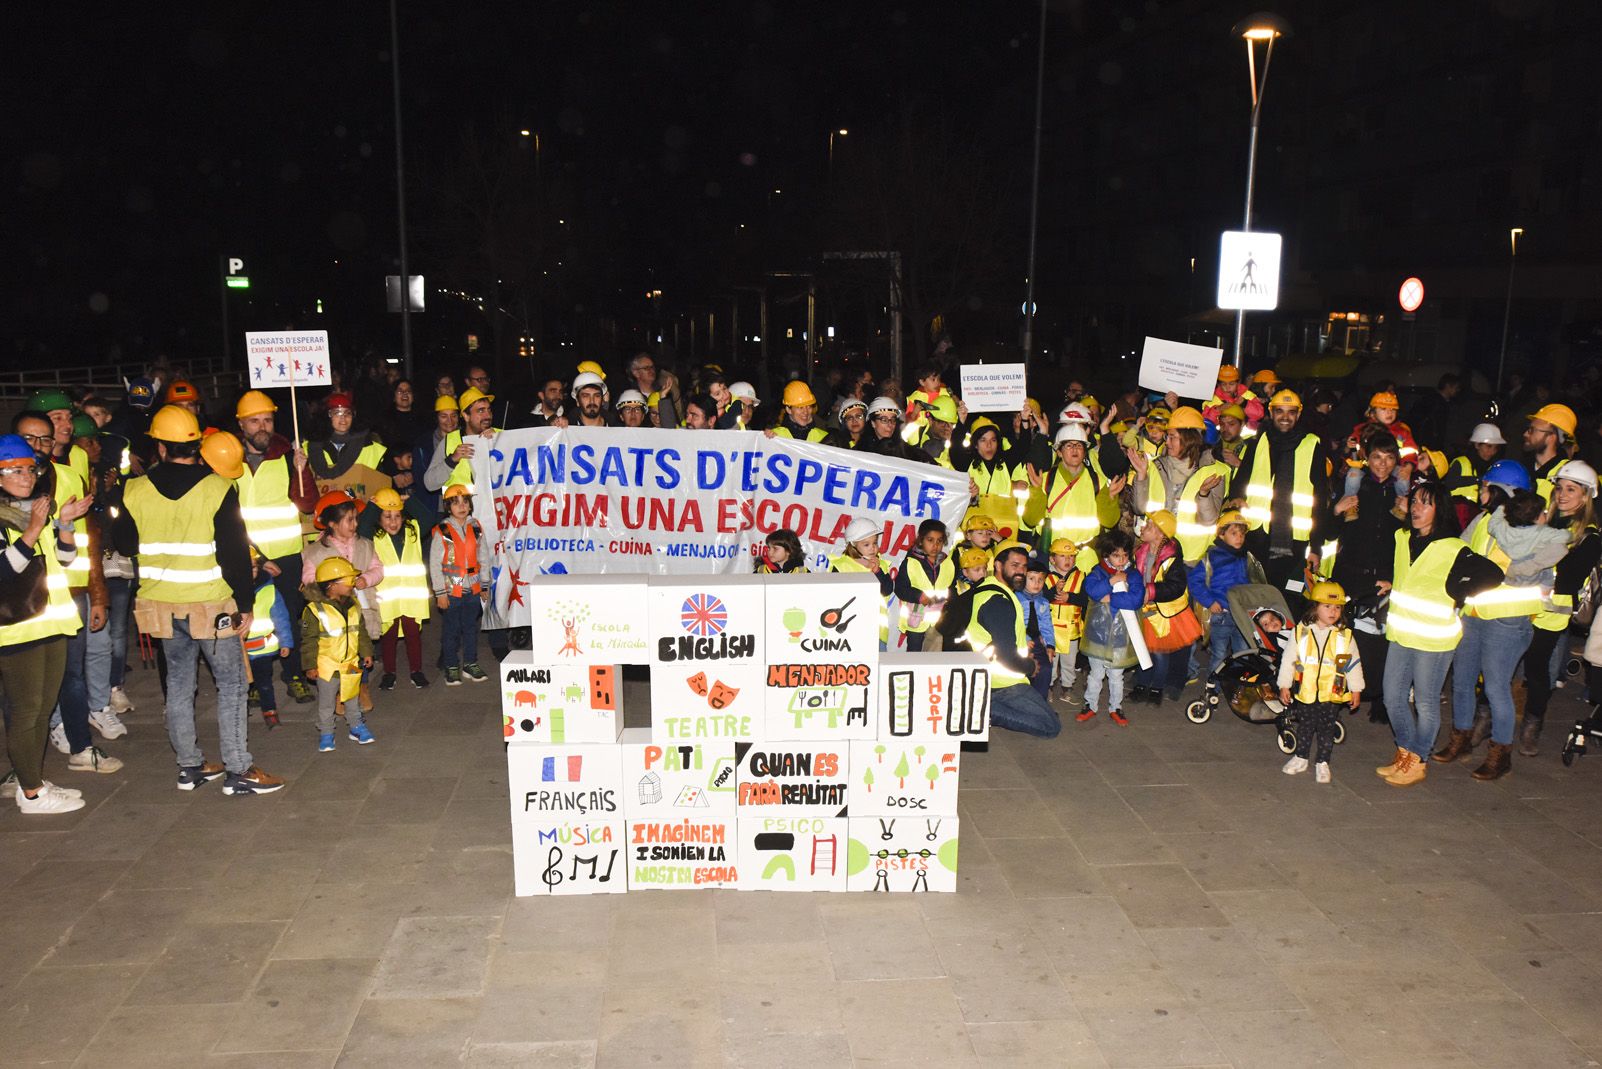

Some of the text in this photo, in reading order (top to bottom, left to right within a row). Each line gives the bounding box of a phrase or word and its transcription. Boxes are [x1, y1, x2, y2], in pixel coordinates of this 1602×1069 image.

[229, 257, 243, 274] P
[250, 336, 324, 345] CANSATS D'ESPERAR
[489, 444, 945, 521] CANSATS D'ESPERAR
[494, 493, 608, 531] EXIGIM
[621, 496, 703, 533] UNA
[717, 498, 852, 545] ESCOLA
[515, 538, 595, 552] BIBLIOTECA
[800, 638, 852, 653] CUINA
[767, 664, 871, 687] MENJADOR
[927, 675, 943, 734] HORT
[664, 714, 751, 738] TEATRE
[749, 752, 839, 778] QUAN ES
[763, 819, 824, 833] PSICO
[636, 846, 649, 861] I
[708, 846, 726, 861] LA
[635, 866, 738, 884] NOSTRA ESCOLA
